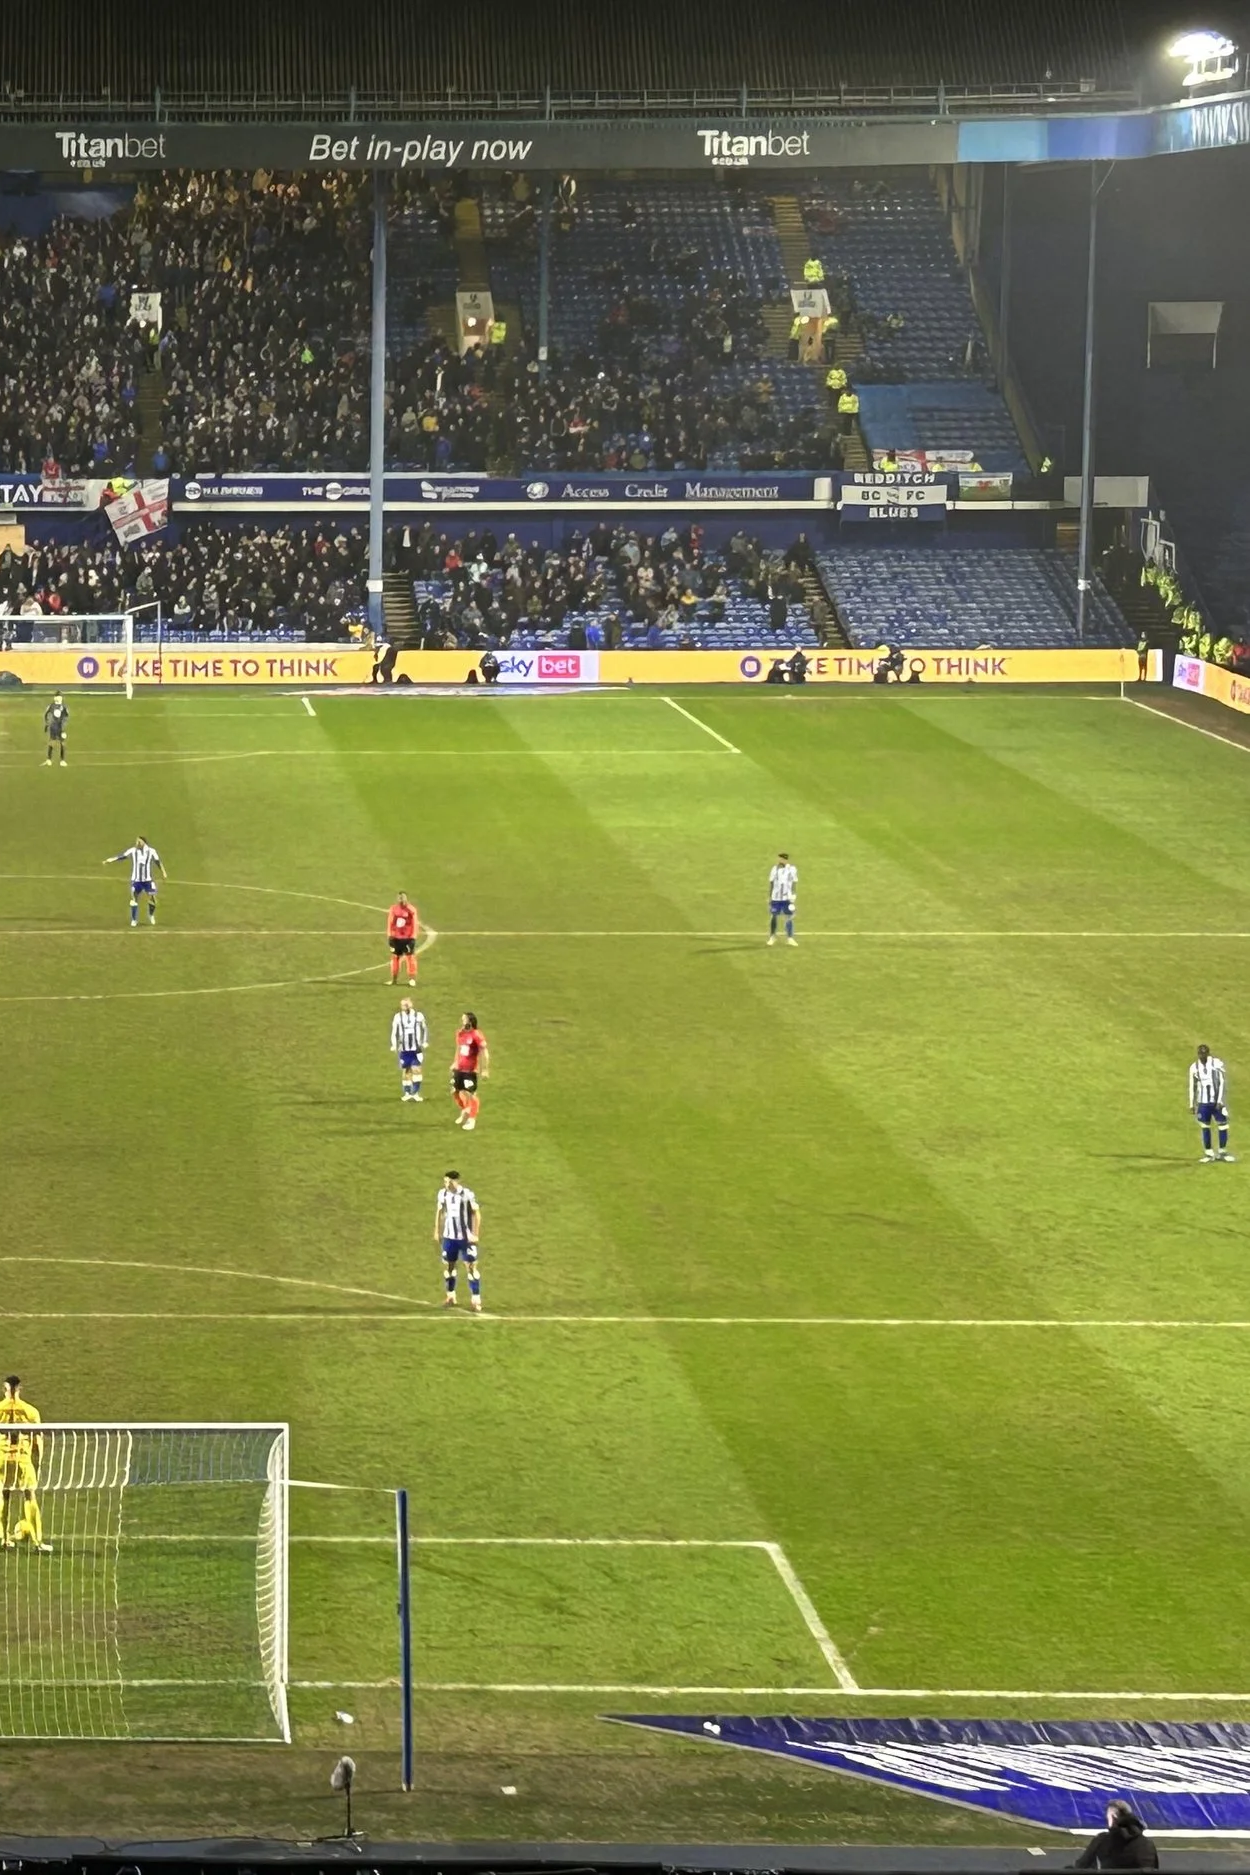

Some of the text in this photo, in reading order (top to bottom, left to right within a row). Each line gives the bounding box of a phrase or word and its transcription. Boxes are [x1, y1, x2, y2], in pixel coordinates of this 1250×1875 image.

[55, 132, 167, 158] Titanbet
[309, 134, 533, 168] Bet in-play now
[697, 129, 810, 156] Titanbet
[561, 482, 779, 499] Access Credit Management
[107, 658, 338, 677] TAKE TIME TO THINK
[499, 656, 577, 677] sky bet
[932, 657, 1008, 676] THINK
